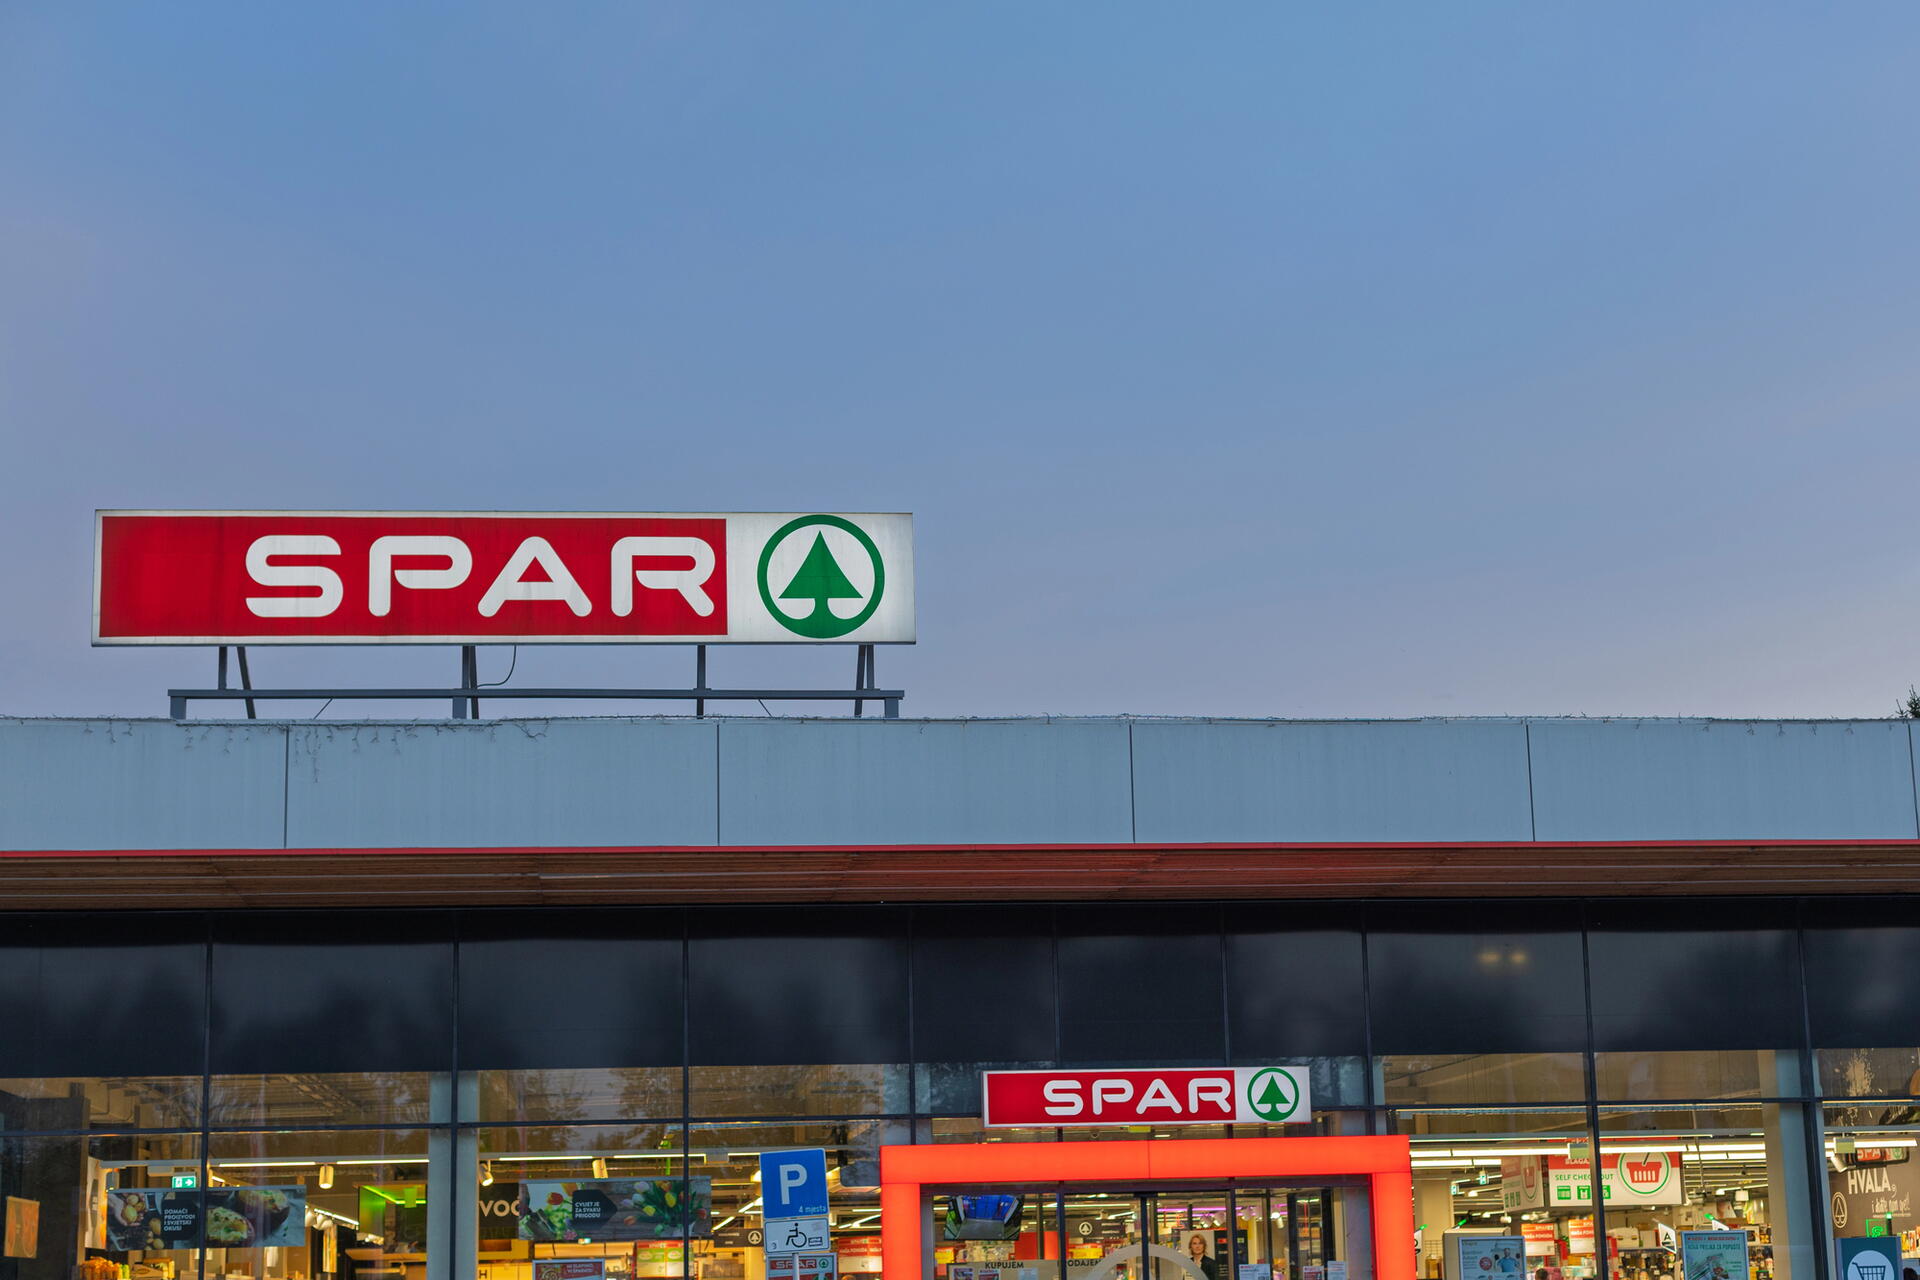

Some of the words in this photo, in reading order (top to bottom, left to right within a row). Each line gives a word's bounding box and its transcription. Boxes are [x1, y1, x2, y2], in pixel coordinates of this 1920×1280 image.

[245, 535, 716, 618] SPAR
[1043, 1077, 1232, 1116] SPAR
[1573, 1173, 1614, 1181] CHECOUT
[780, 1164, 808, 1205] P
[798, 1205, 804, 1213] 4
[775, 1260, 816, 1269] SPAR
[985, 1261, 1025, 1269] KUPUJEM
